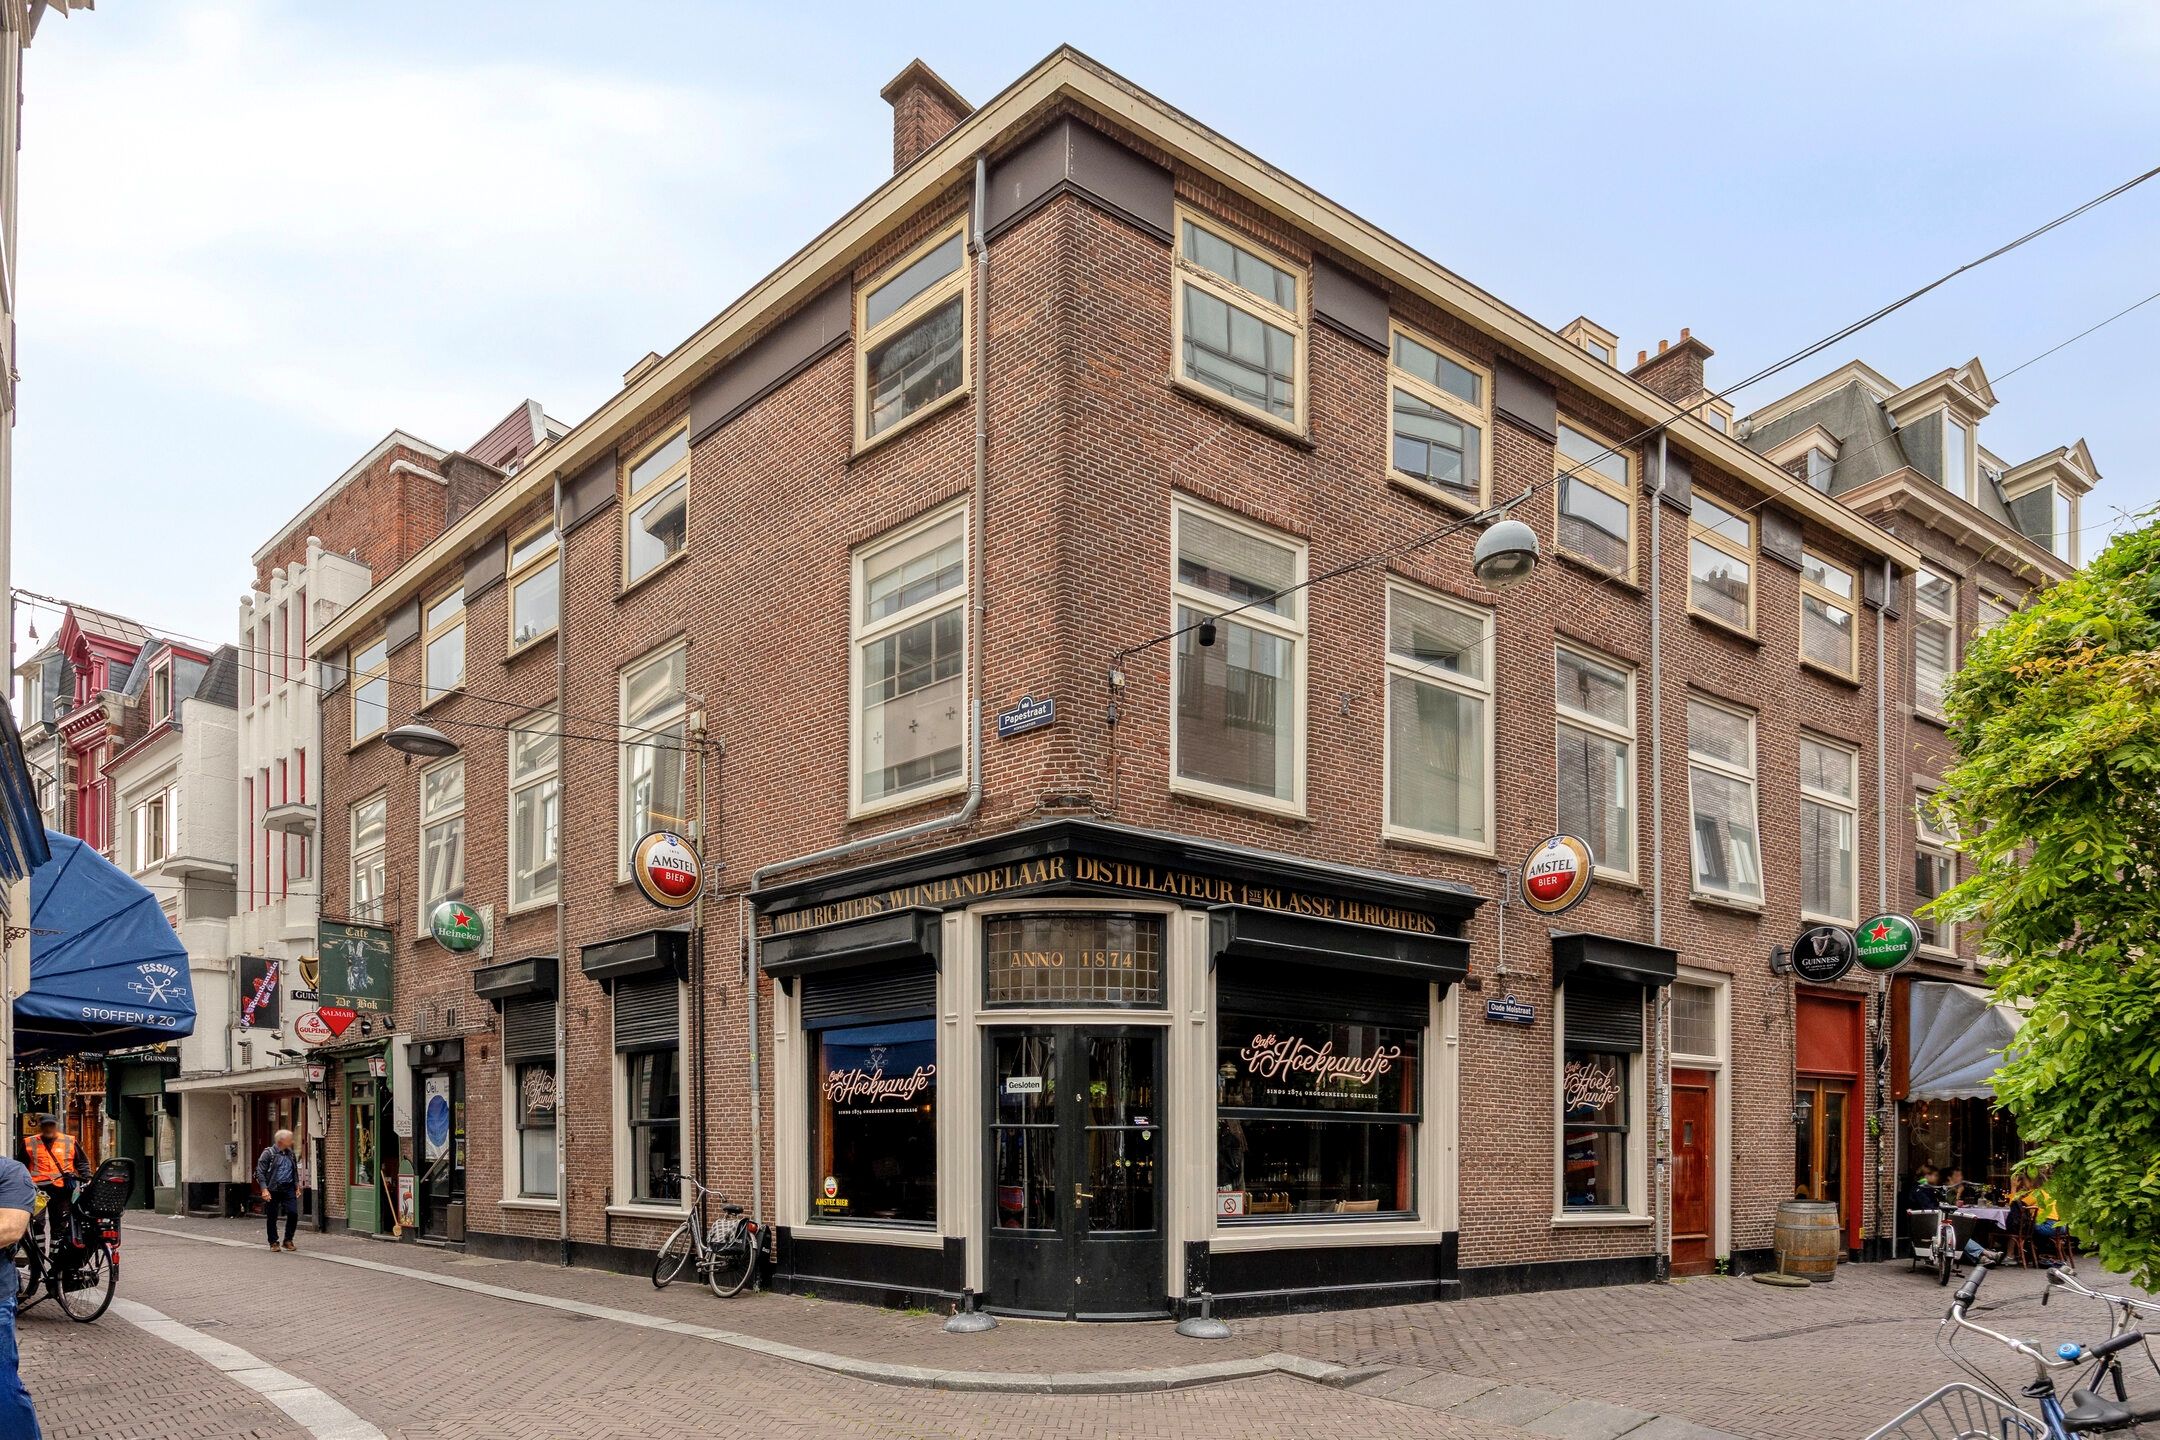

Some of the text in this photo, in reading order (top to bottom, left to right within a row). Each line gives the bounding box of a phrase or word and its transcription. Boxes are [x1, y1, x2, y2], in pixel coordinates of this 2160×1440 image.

[1004, 704, 1047, 725] Papestraat
[652, 855, 695, 874] AMSTEL
[1529, 859, 1573, 877] AMSTEL
[665, 872, 685, 883] BIER
[889, 856, 1066, 909] WIJNHANDELAAR
[1538, 877, 1558, 887] BIER
[1076, 856, 1234, 905] DISTILLATEUR
[1263, 887, 1335, 919] KLASSE
[438, 927, 481, 942] Heineken
[1857, 943, 1908, 956] Heineken
[1010, 951, 1133, 968] ANNO 1874
[1801, 955, 1840, 966] GUINNESS
[136, 963, 178, 978] TESSUTI
[295, 991, 318, 999] GUIN
[335, 996, 378, 1009] De Bok
[1490, 1003, 1532, 1015] Oude Molstraat
[82, 1006, 176, 1027] STOFFEN & ZO
[321, 1010, 355, 1018] SALMARI
[1251, 1034, 1277, 1049] Café
[144, 1054, 178, 1063] GUINNESS
[1008, 1081, 1040, 1089] Gesloten
[1287, 1088, 1303, 1097] 1874
